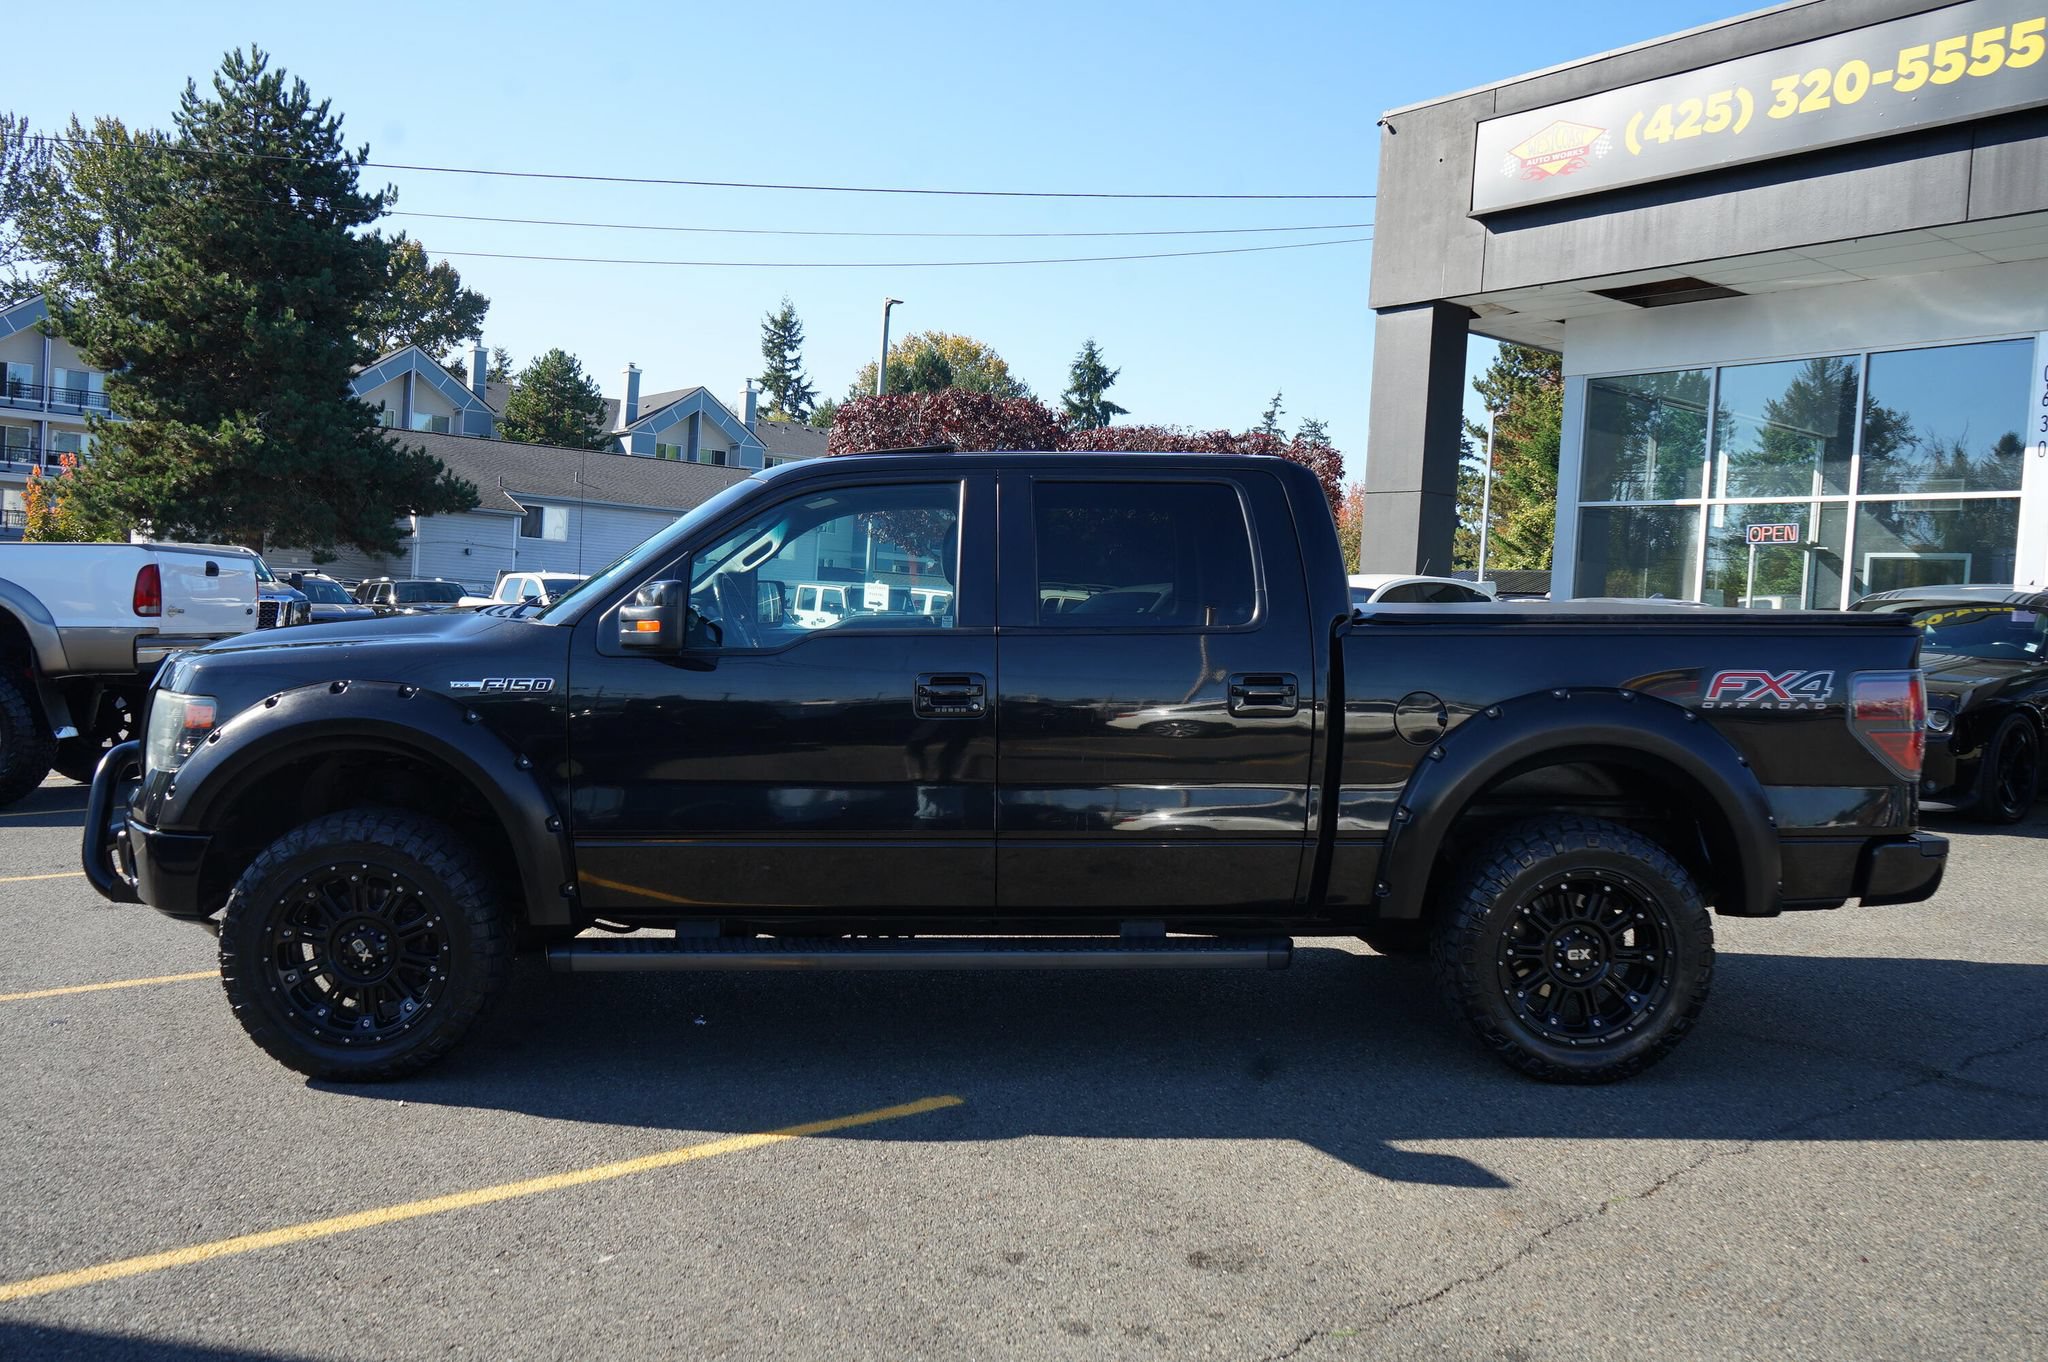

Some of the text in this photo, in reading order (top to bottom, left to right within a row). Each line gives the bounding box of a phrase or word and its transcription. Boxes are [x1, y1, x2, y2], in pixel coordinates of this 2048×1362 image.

[1624, 17, 2047, 155] (425) 320-5555
[1526, 148, 1585, 166] AUTO WORKS
[1750, 525, 1796, 541] OPEN
[480, 678, 555, 693] F-150
[1704, 670, 1835, 702] FX4
[1760, 702, 1828, 710] ROAD
